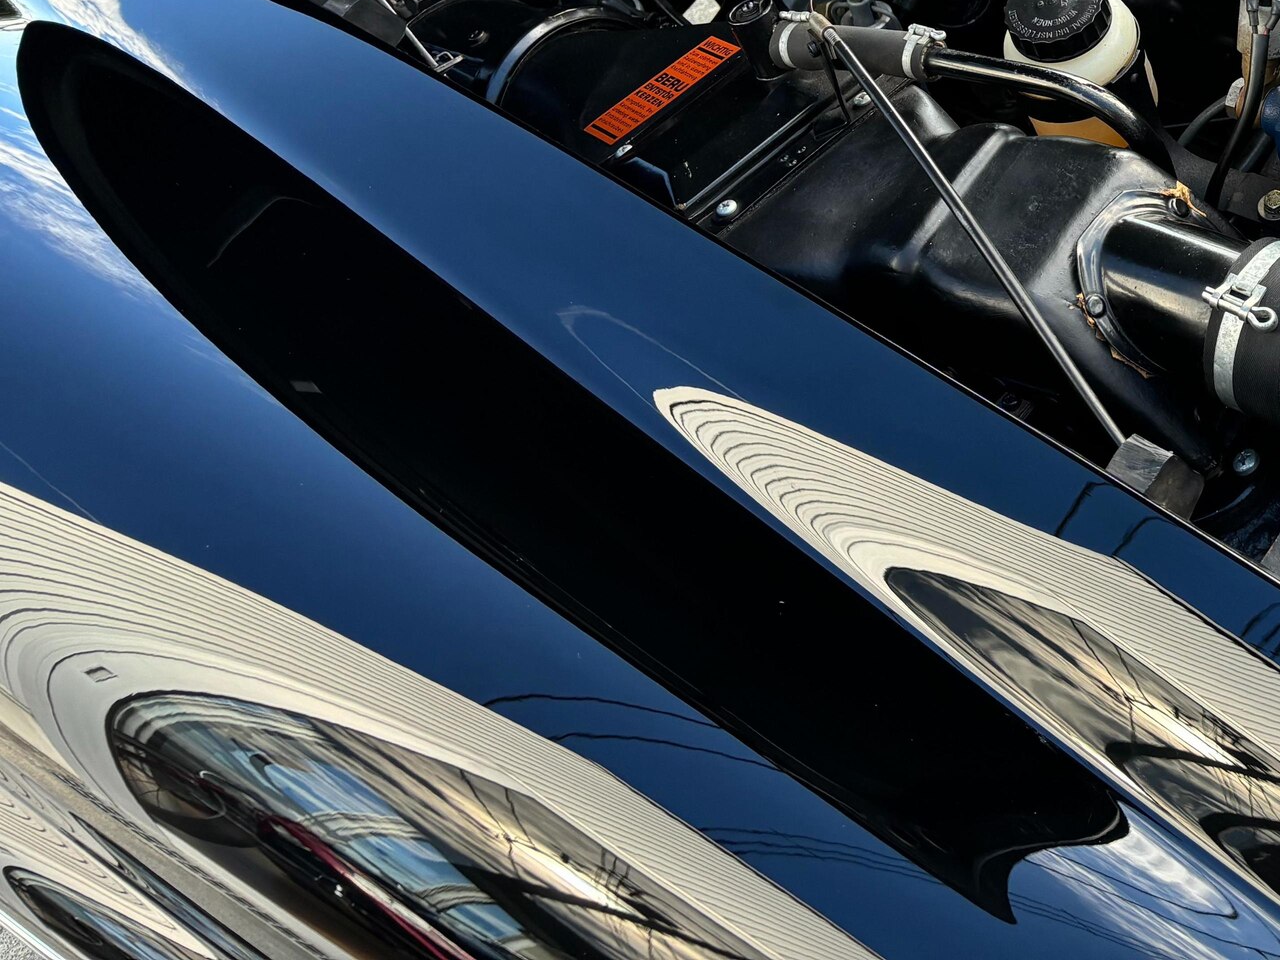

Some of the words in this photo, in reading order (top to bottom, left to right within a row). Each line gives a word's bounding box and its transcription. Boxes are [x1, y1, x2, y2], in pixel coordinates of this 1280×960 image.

[1031, 8, 1079, 27] VERWENDEN
[701, 39, 734, 56] WICHTIG
[642, 81, 676, 100] ENTSTÖR
[653, 71, 690, 92] BERU
[632, 89, 665, 107] KERZEN
